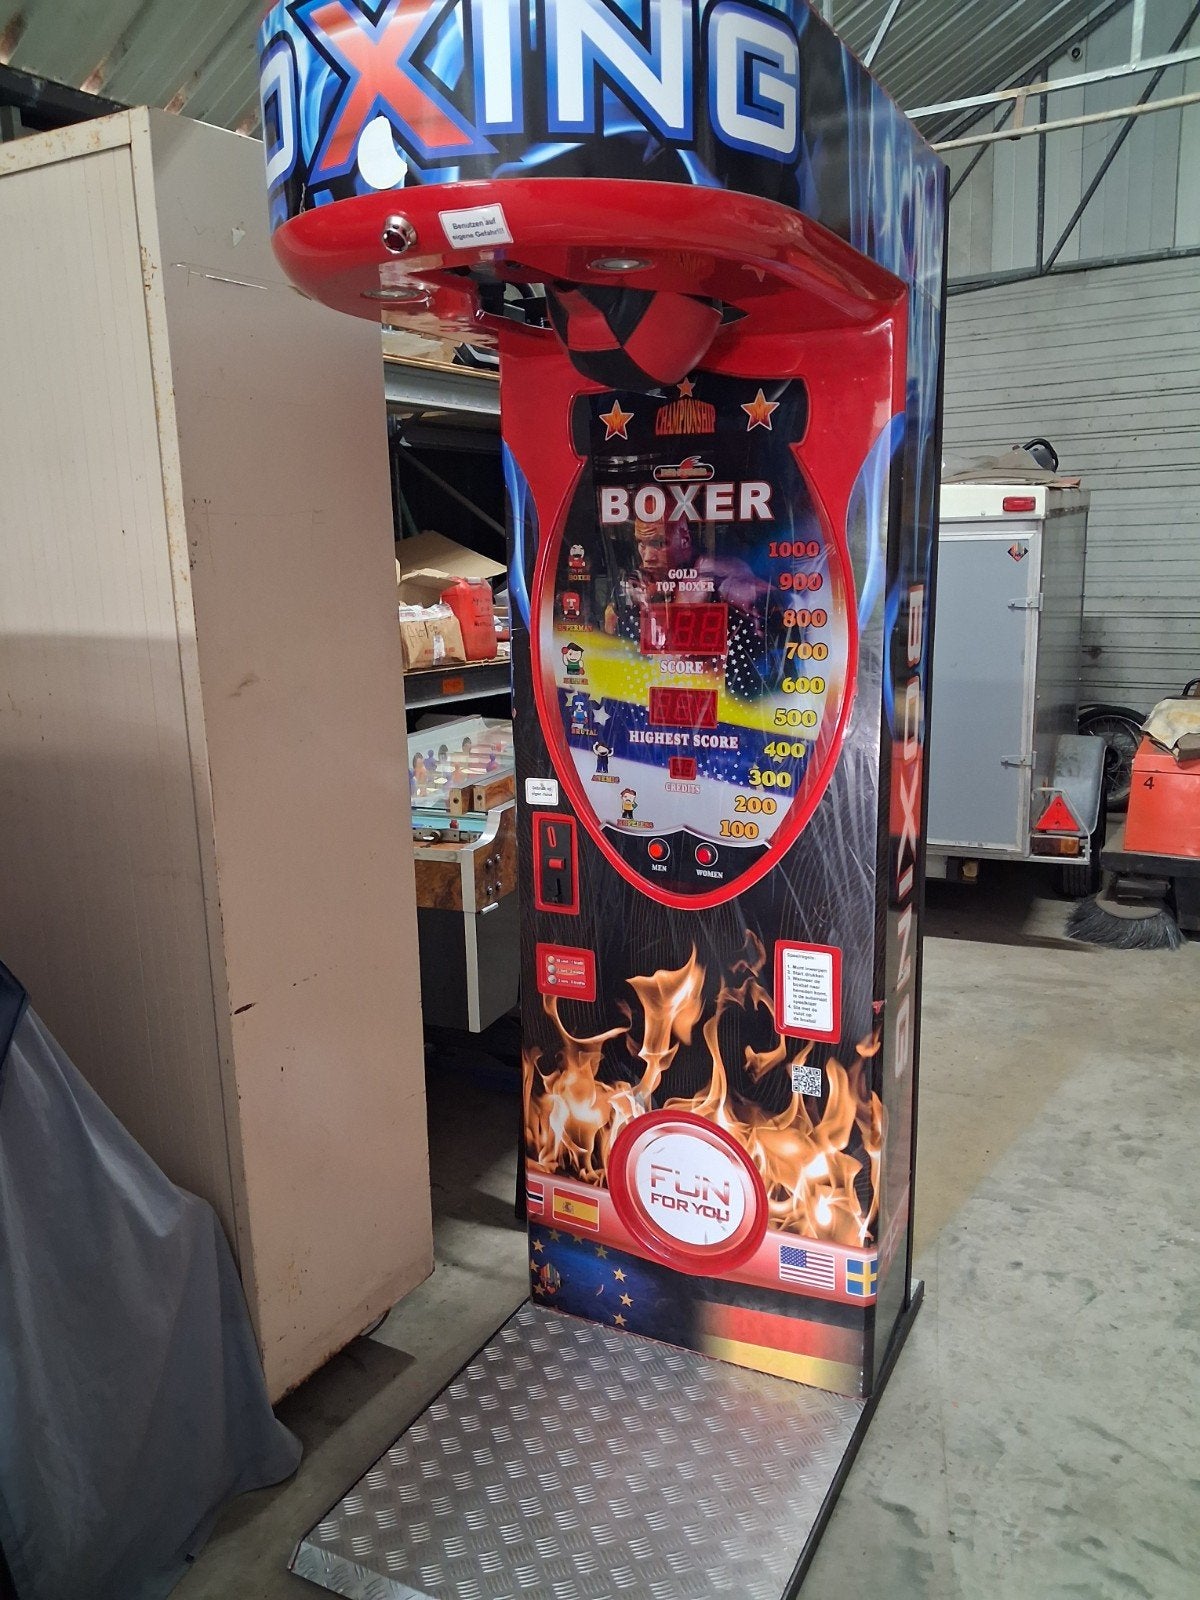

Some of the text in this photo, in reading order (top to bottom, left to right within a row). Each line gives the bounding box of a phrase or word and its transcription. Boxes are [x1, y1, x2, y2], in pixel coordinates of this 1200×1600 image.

[452, 217, 497, 230] Benutzen auf
[452, 233, 474, 241] eigene
[655, 398, 716, 435] CHAMPIONSHIP
[601, 481, 774, 523] BOXER
[768, 541, 820, 558] 1000
[668, 568, 698, 580] GOLD
[778, 573, 822, 591] 900
[656, 580, 715, 592] TOP BOXER
[782, 609, 827, 628] 800
[786, 643, 828, 661] 700
[660, 660, 704, 674] SCORE
[781, 677, 825, 694] 600
[774, 709, 817, 727] 500
[629, 731, 739, 749] HIGHEST SCORE
[763, 741, 806, 758] 400
[665, 782, 700, 794] CREDITS
[749, 770, 791, 789] 300
[1144, 777, 1154, 789] 4
[734, 797, 777, 815] 200
[720, 820, 759, 839] 100
[651, 864, 667, 872] MEN
[696, 868, 723, 879] WOMEN
[651, 1164, 729, 1206] FUN
[651, 1192, 729, 1222] FOR YOU
